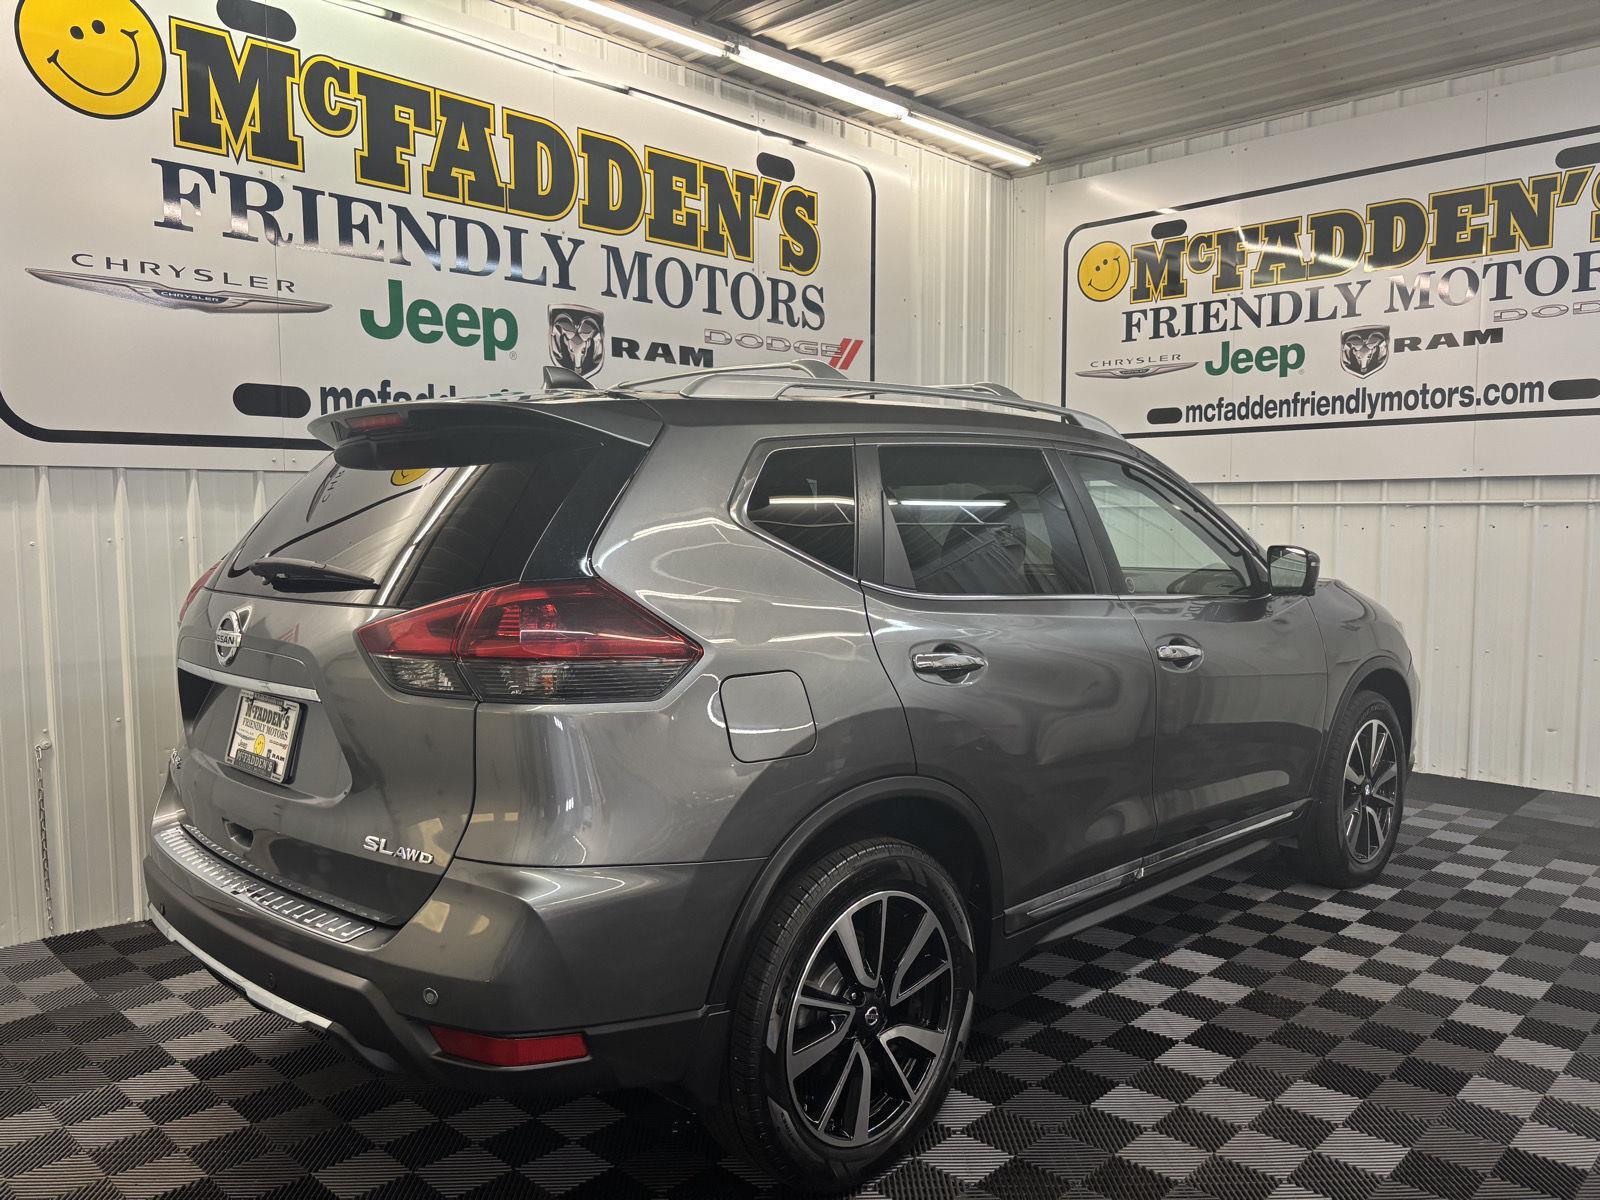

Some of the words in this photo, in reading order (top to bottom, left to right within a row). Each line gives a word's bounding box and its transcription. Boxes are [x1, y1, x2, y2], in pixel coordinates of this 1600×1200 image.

[151, 158, 584, 291] FRIENDLY
[601, 244, 825, 331] MOTORS
[1129, 165, 1600, 304] McFADDEN'
[71, 253, 296, 293] CHRYSLER
[160, 290, 219, 302] CHRYSLER
[1121, 279, 1371, 343] FRIENDLY
[360, 279, 518, 361] Jeep
[611, 336, 714, 368] RAM
[704, 328, 843, 358] DODGE
[1393, 327, 1503, 353] RAM
[1090, 353, 1182, 368] CHRYSLER
[1205, 341, 1305, 377] Jeep
[1185, 380, 1544, 424] mcfaddenfriendlymotors.com
[266, 725, 288, 740] MOTORS
[363, 835, 394, 856] SL
[393, 846, 434, 864] AWD
